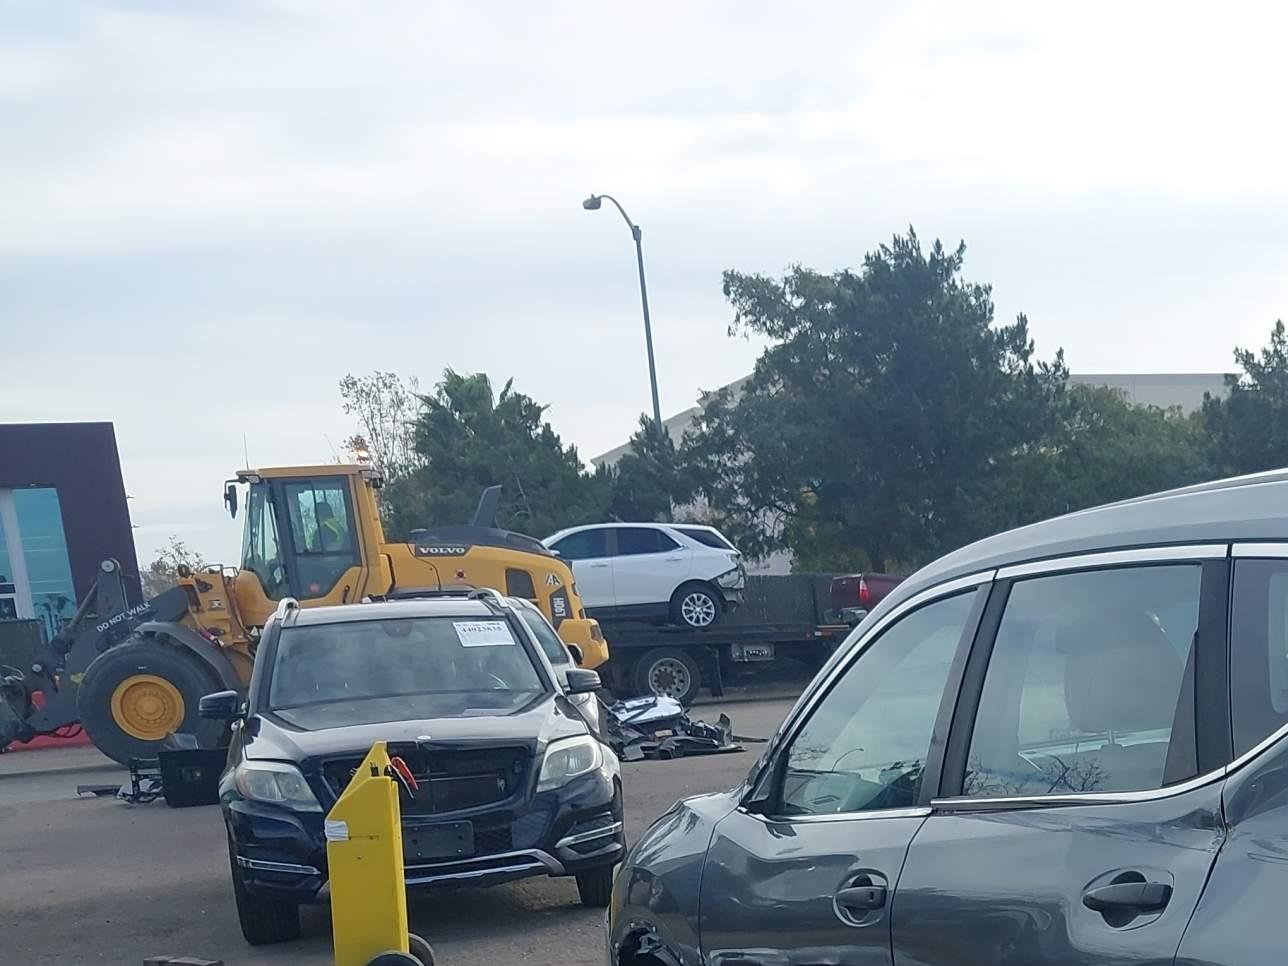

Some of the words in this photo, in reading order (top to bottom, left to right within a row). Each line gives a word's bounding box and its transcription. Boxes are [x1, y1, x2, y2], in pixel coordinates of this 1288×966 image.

[96, 622, 109, 632] DO
[109, 612, 126, 626] NOT
[127, 601, 151, 616] WALK
